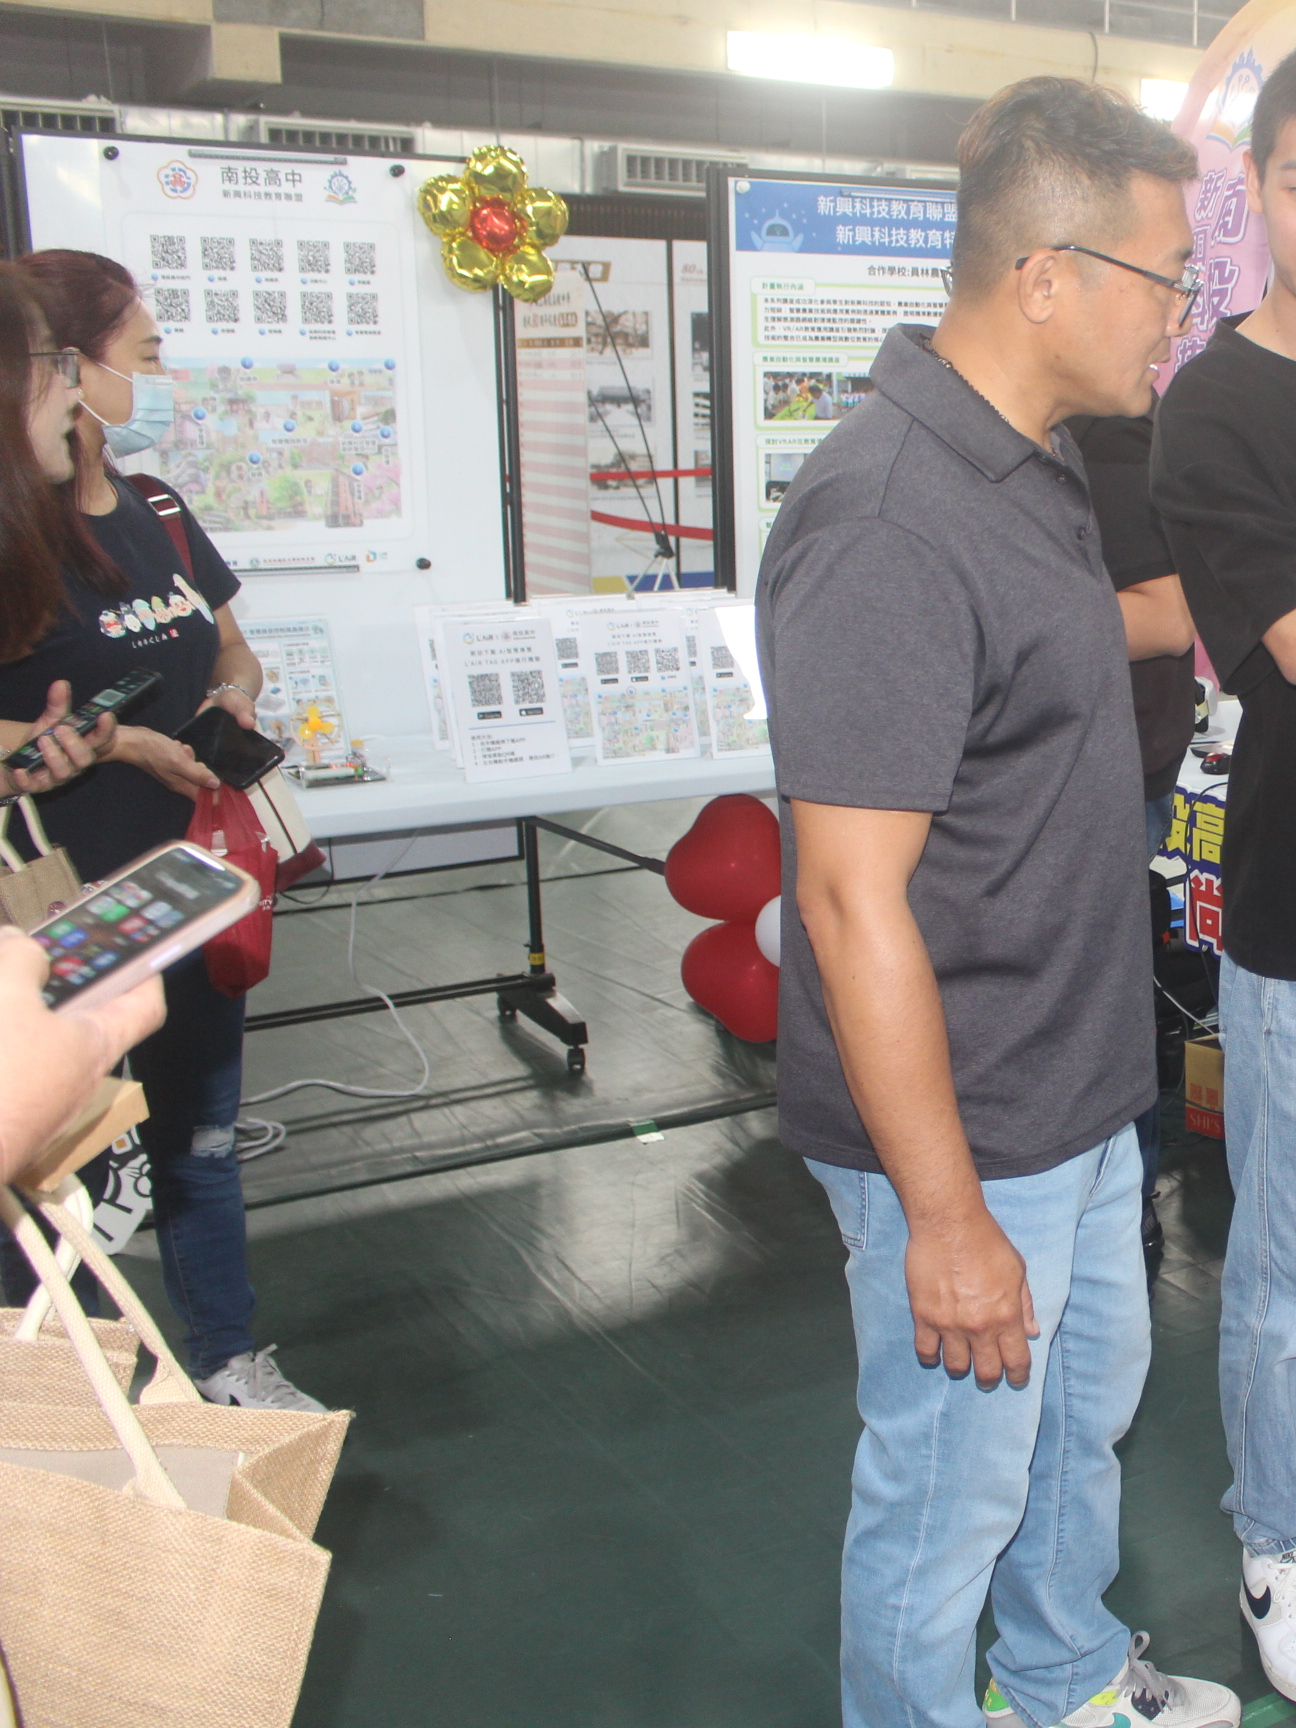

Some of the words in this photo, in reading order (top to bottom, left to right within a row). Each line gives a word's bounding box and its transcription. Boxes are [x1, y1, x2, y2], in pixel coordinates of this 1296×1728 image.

[219, 166, 303, 189] 南投高中
[222, 189, 304, 202] 新興科技教育聯盟
[868, 264, 942, 280] 合作學校:員林農
